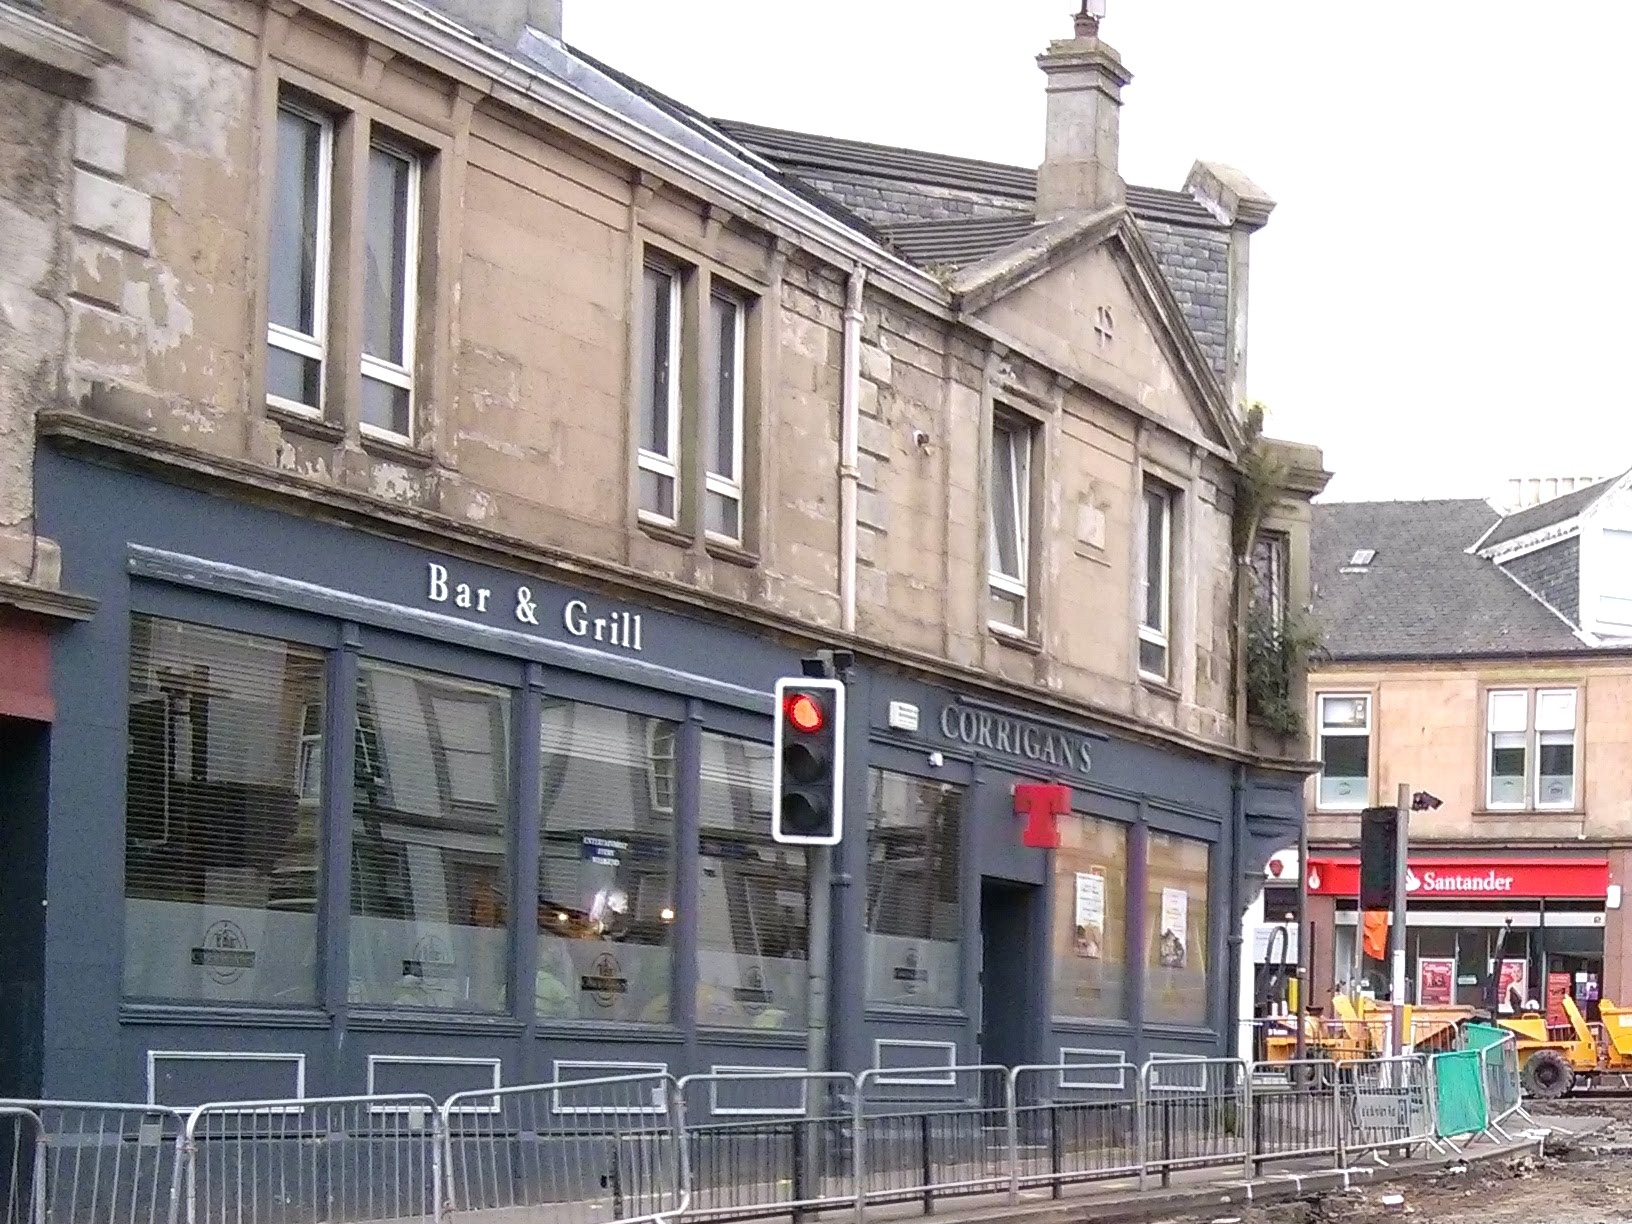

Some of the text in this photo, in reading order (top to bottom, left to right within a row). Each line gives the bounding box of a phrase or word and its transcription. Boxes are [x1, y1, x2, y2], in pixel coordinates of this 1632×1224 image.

[428, 562, 642, 650] Bar & Grill
[941, 704, 1092, 774] CORRIGAN'S
[1423, 871, 1513, 892] Santander
